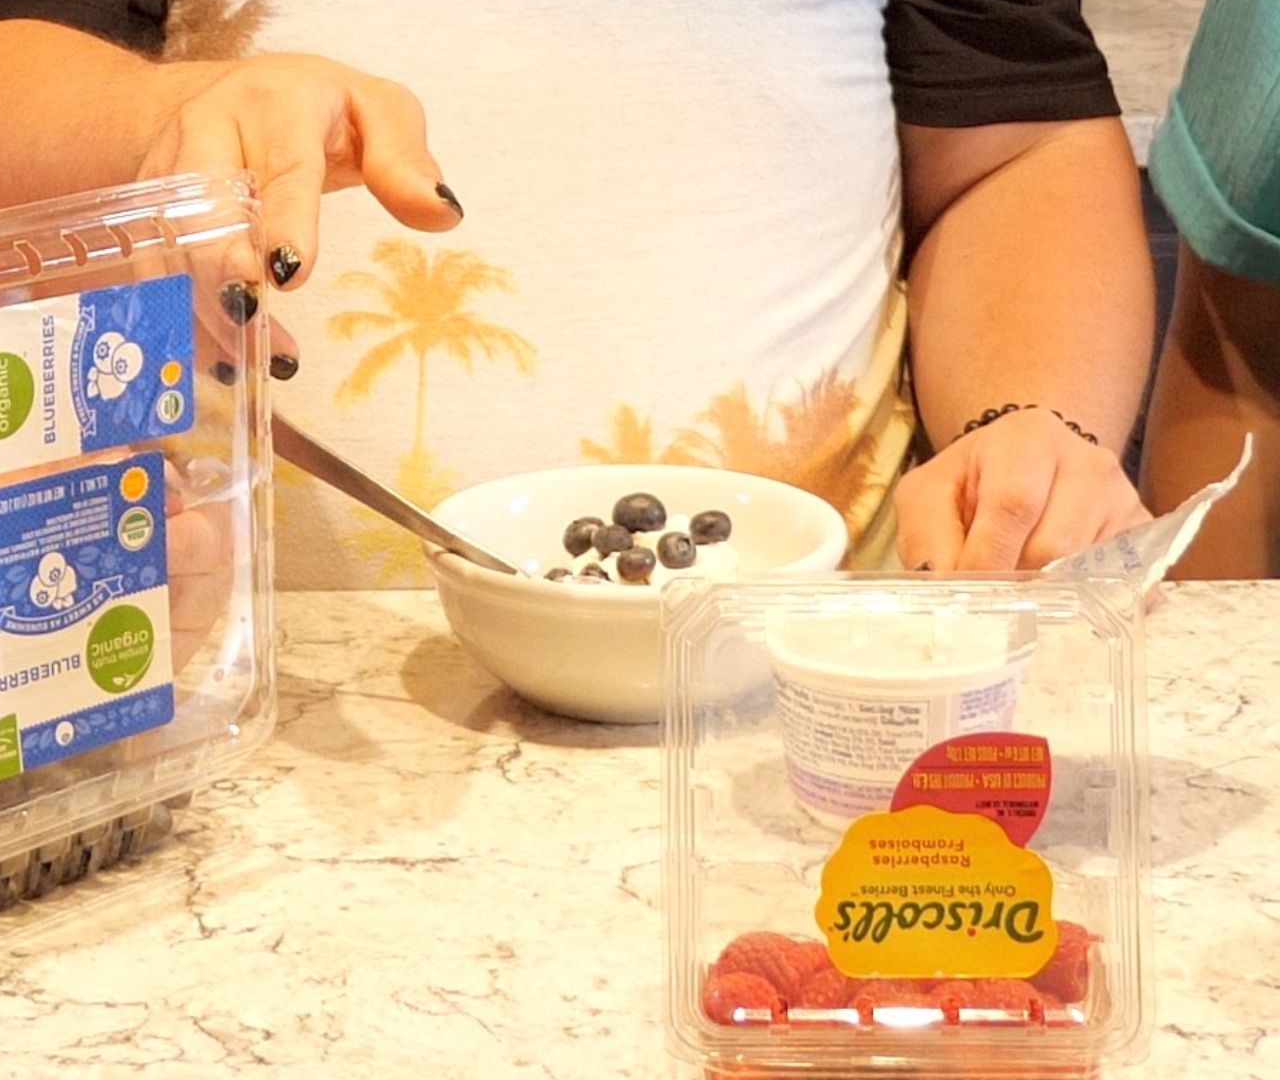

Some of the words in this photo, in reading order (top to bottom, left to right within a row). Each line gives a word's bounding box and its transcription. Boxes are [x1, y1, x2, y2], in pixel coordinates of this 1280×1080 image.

[42, 315, 56, 444] BLUEBERRIES
[91, 629, 150, 657] organic
[91, 650, 118, 669] truth
[118, 644, 150, 662] simple
[869, 838, 965, 852] Framboises
[872, 853, 971, 868] Raspberries
[860, 884, 908, 897] Berries
[912, 884, 954, 897] Finest
[958, 884, 981, 896] the
[985, 882, 1016, 897] Only
[834, 900, 1045, 944] Driscoll's
